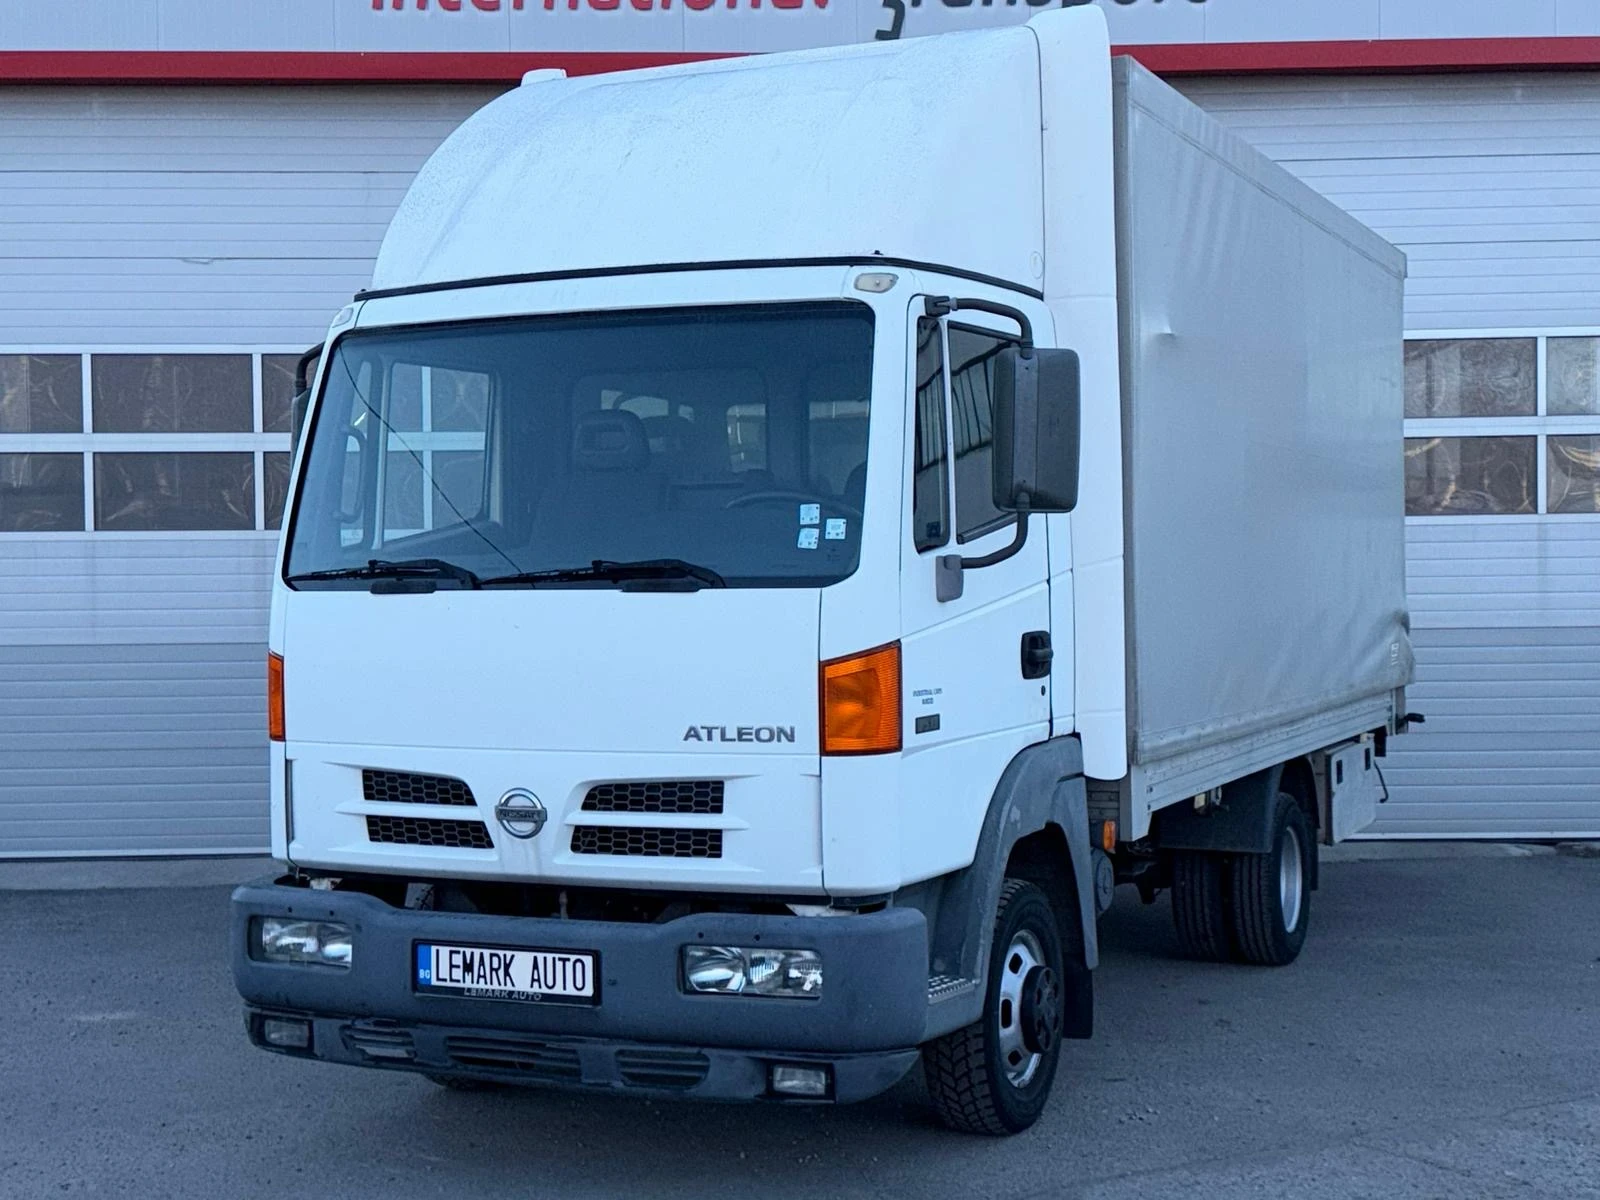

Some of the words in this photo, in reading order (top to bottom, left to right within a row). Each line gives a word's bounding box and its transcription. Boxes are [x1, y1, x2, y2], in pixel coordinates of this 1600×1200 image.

[683, 725, 796, 743] ATLEON
[419, 969, 431, 979] BG
[435, 948, 516, 988] LEMARK
[530, 955, 586, 992] AUTO
[463, 987, 509, 999] LEMARK
[511, 989, 542, 1001] AUTO
